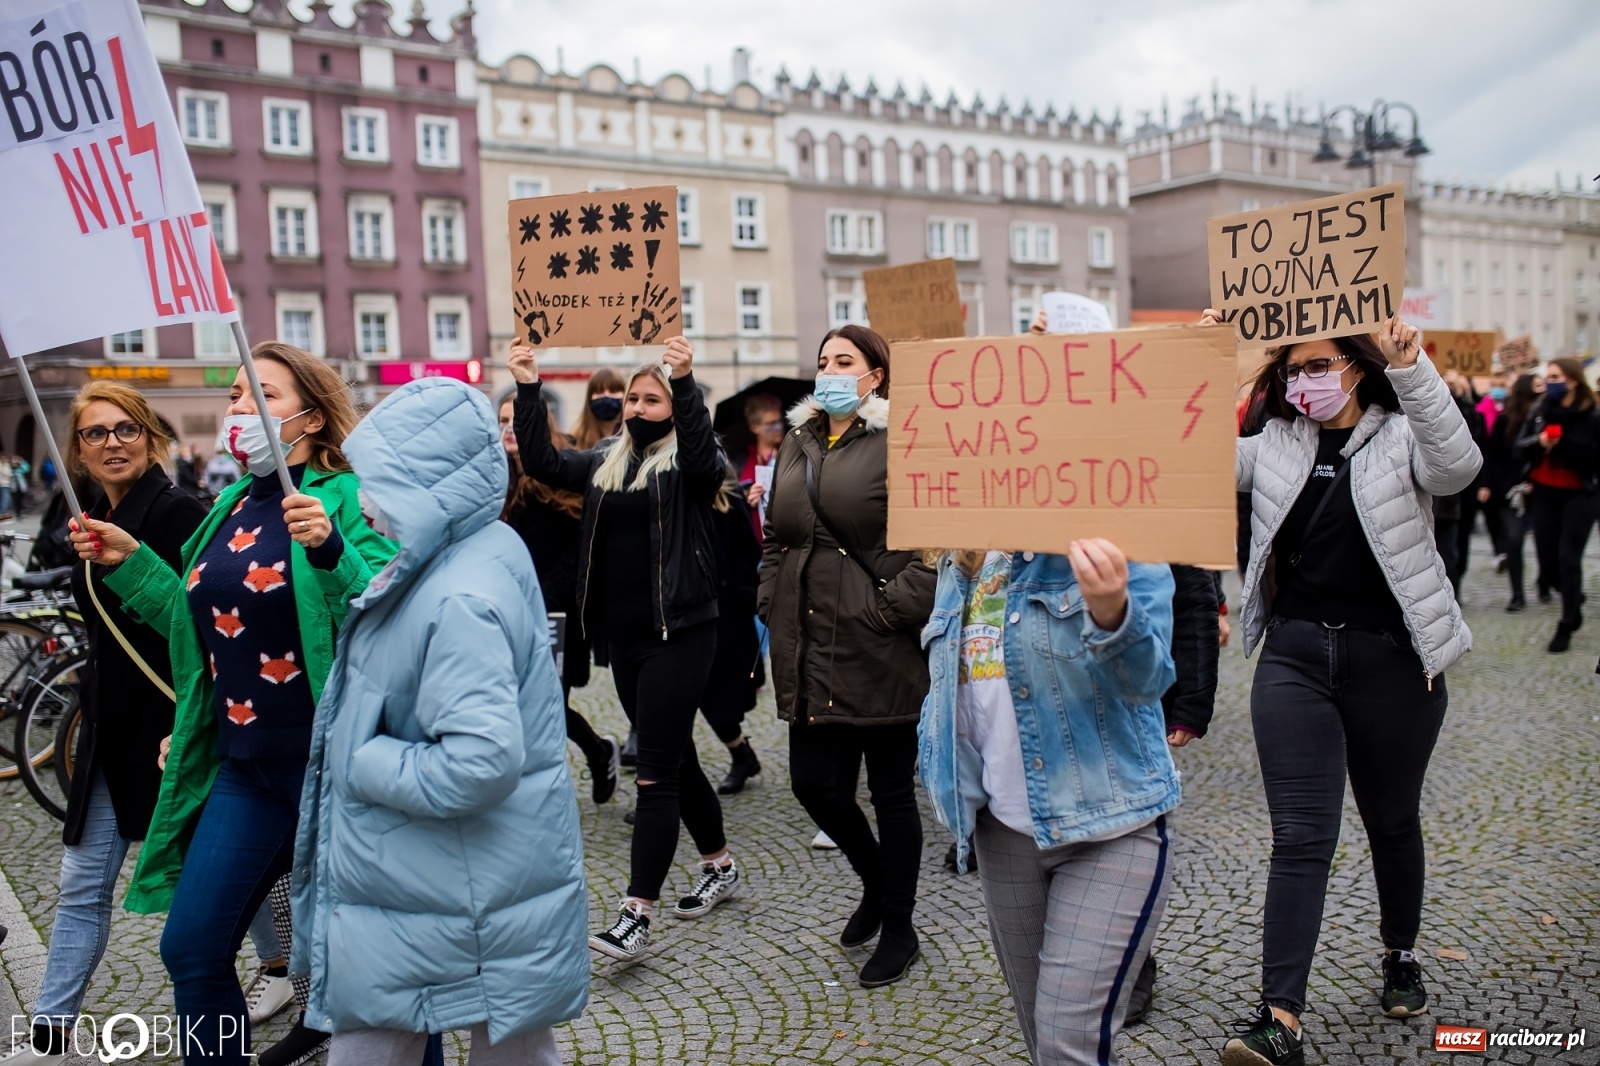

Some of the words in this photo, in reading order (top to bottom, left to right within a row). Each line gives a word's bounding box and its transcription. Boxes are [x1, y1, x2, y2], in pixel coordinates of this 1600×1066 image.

[53, 134, 144, 235] NIE
[1221, 218, 1273, 258] TO
[1289, 192, 1395, 256] JEST
[1221, 253, 1340, 301] WOJNA
[1350, 246, 1379, 285] Z
[542, 293, 592, 309] GODEK
[928, 338, 1148, 410] GODEK
[1444, 349, 1487, 373] SUS
[944, 416, 1039, 458] WAS
[905, 472, 961, 508] THE
[980, 457, 1160, 508] IMPOSTOR
